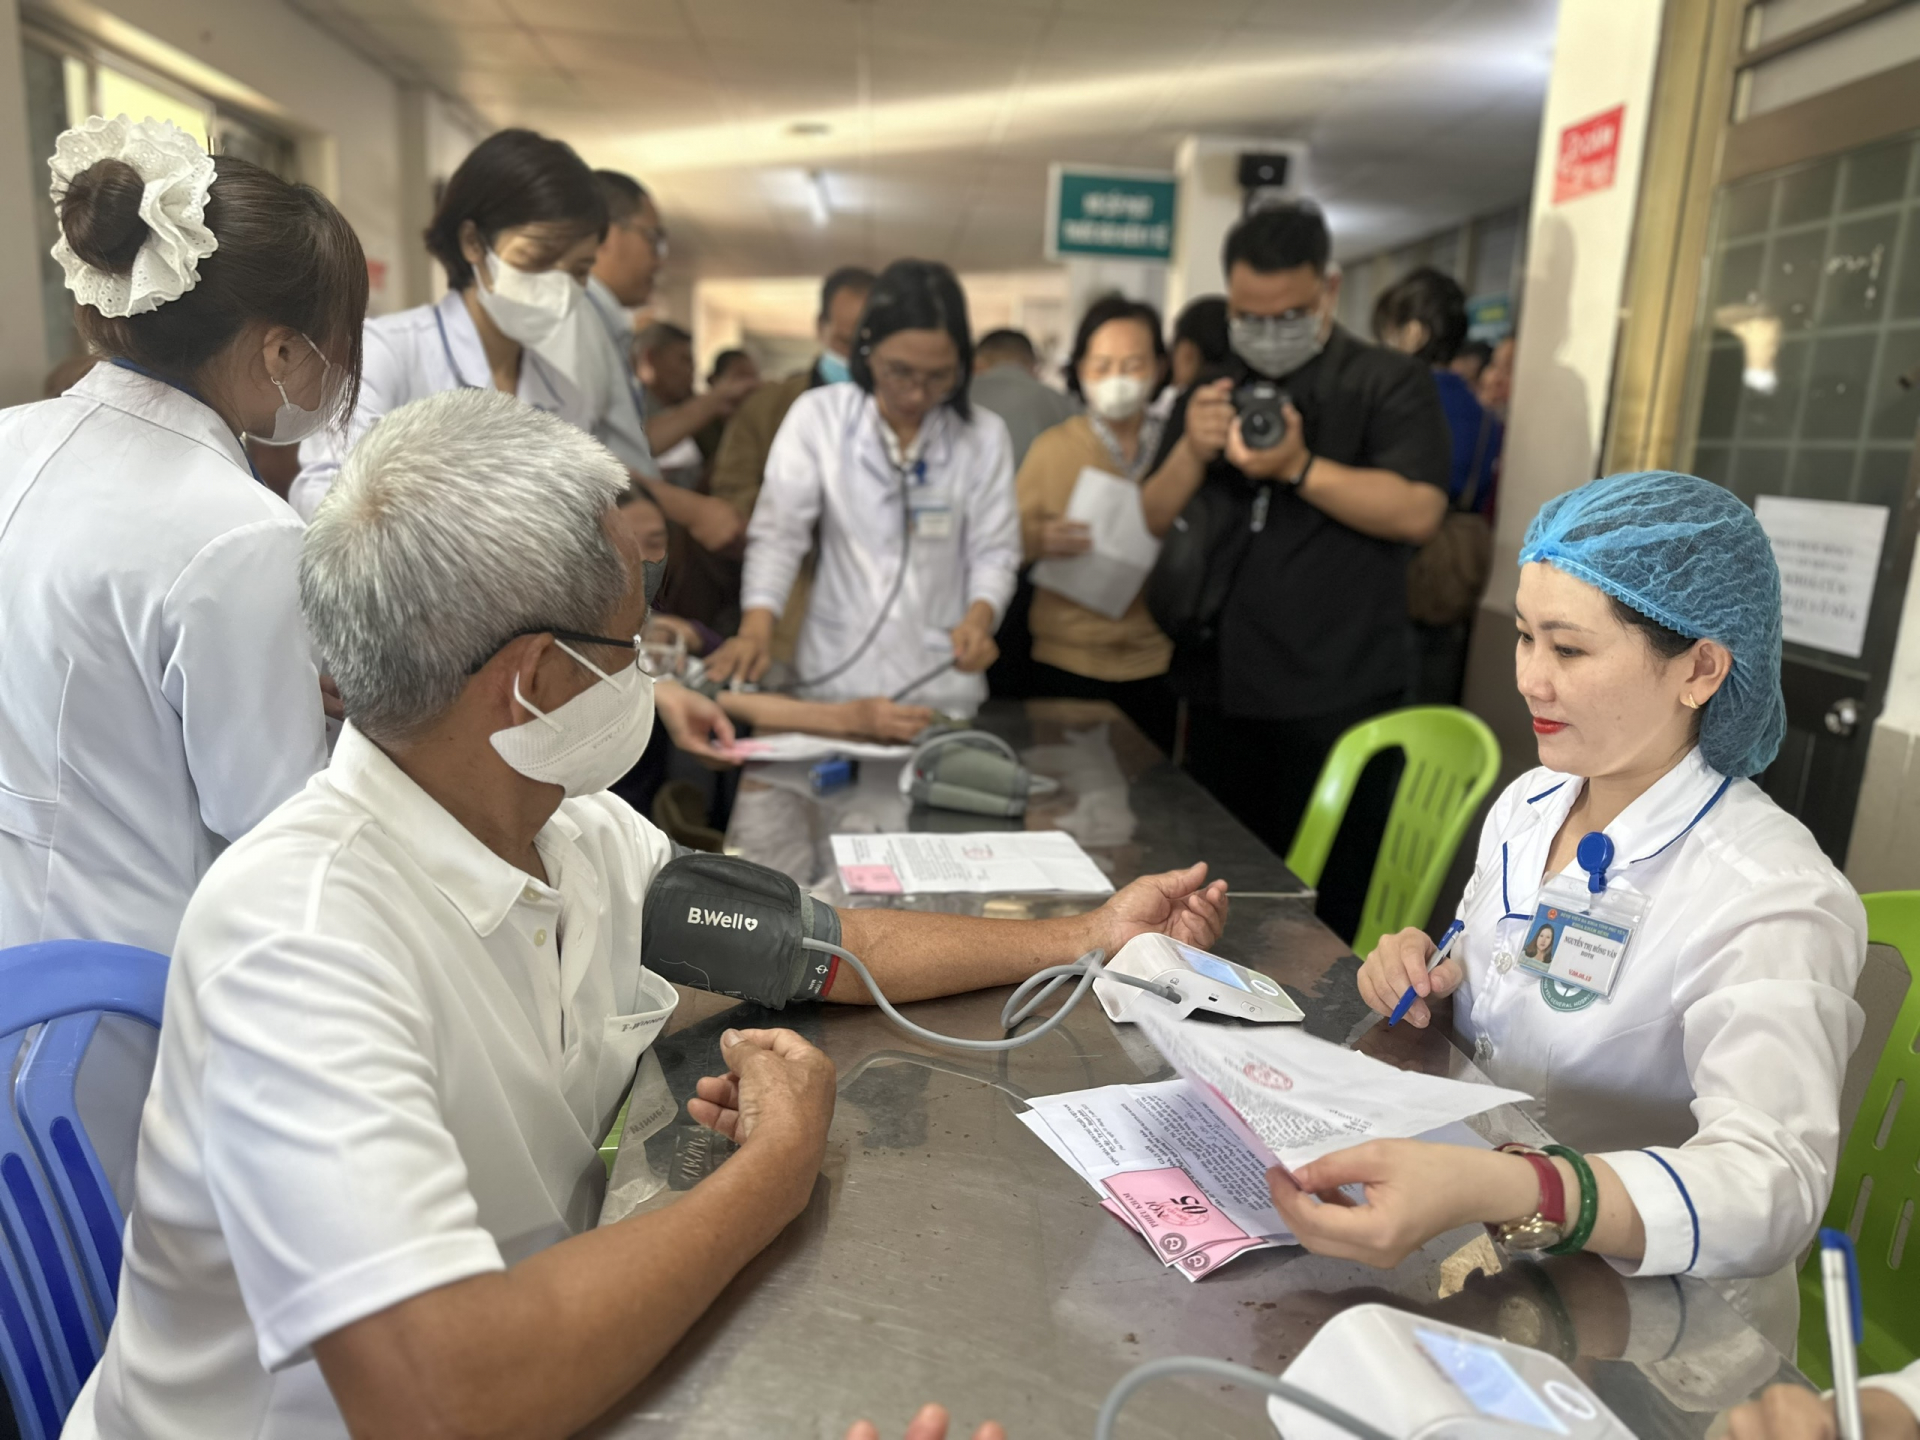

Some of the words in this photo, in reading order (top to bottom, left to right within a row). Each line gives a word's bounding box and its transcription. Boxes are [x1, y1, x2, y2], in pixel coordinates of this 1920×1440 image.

[687, 907, 743, 930] B.Well
[1550, 998, 1572, 1008] GENERAL
[1170, 1196, 1208, 1214] 05
